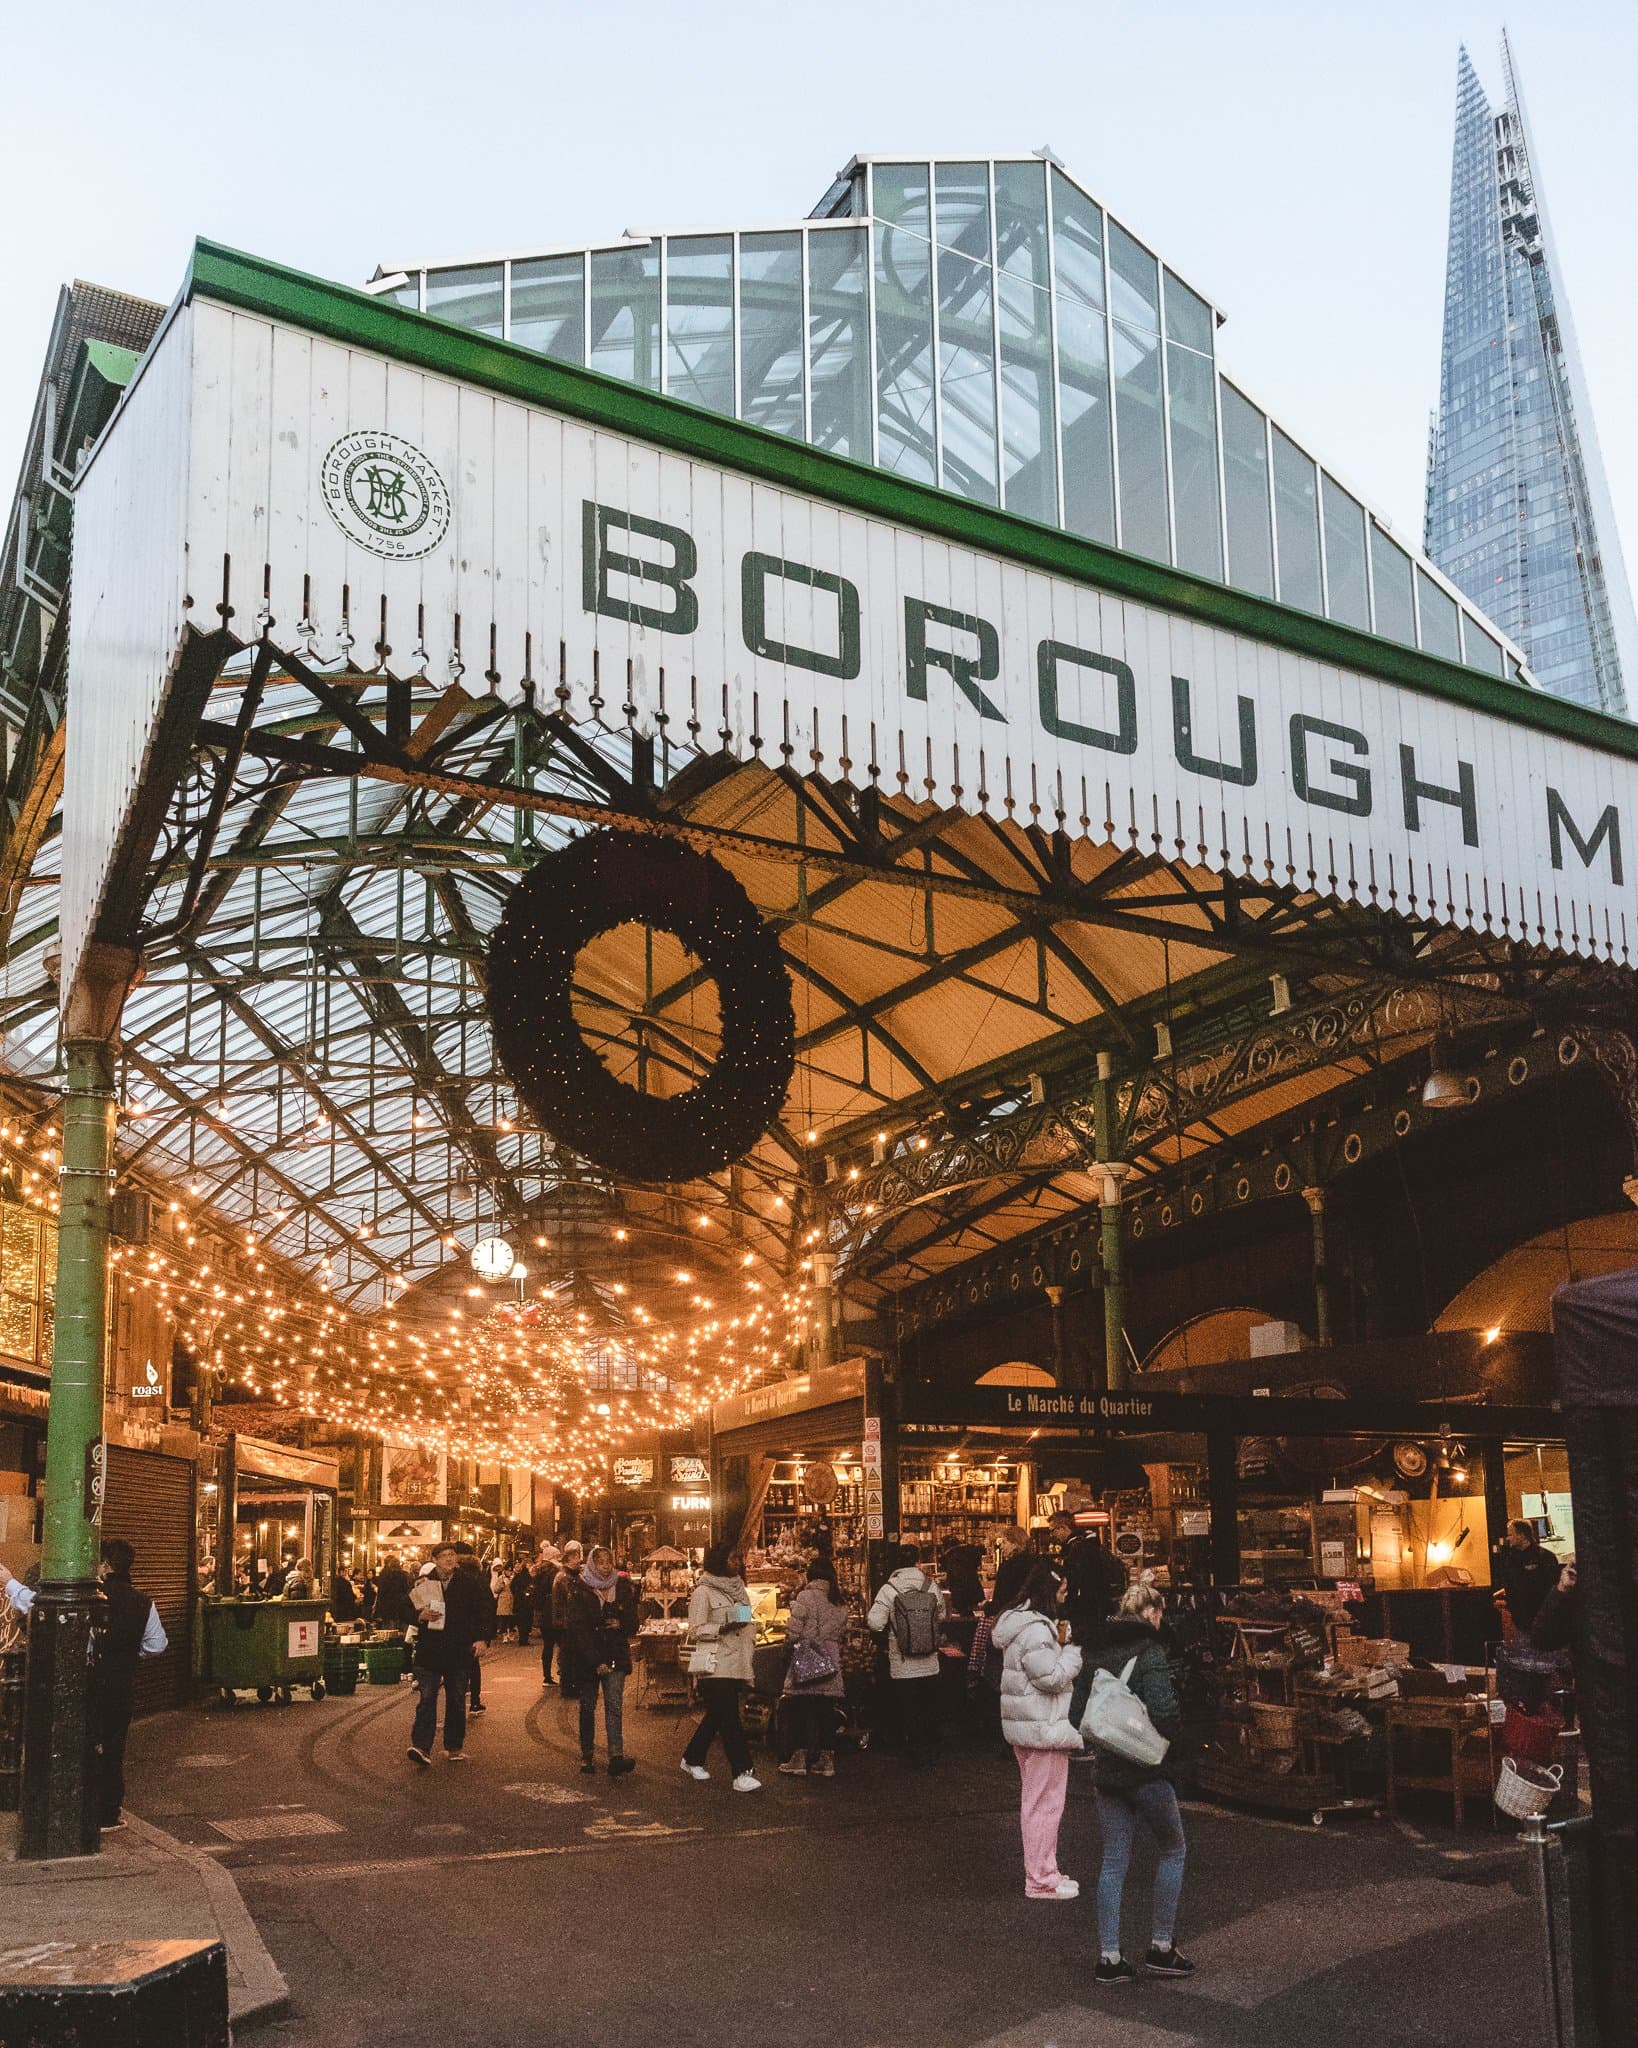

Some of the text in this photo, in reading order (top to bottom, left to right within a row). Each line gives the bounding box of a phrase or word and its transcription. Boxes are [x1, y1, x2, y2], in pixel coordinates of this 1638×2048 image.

[329, 439, 392, 499] BOROUGH
[403, 451, 443, 528] MARKET
[348, 500, 377, 530] BOROUGH
[367, 533, 405, 550] 1756
[583, 500, 1479, 849] BOROUGH
[132, 1385, 163, 1396] roast
[1008, 1393, 1153, 1418] Le Marché du Quartier
[672, 1496, 711, 1510] FURN
